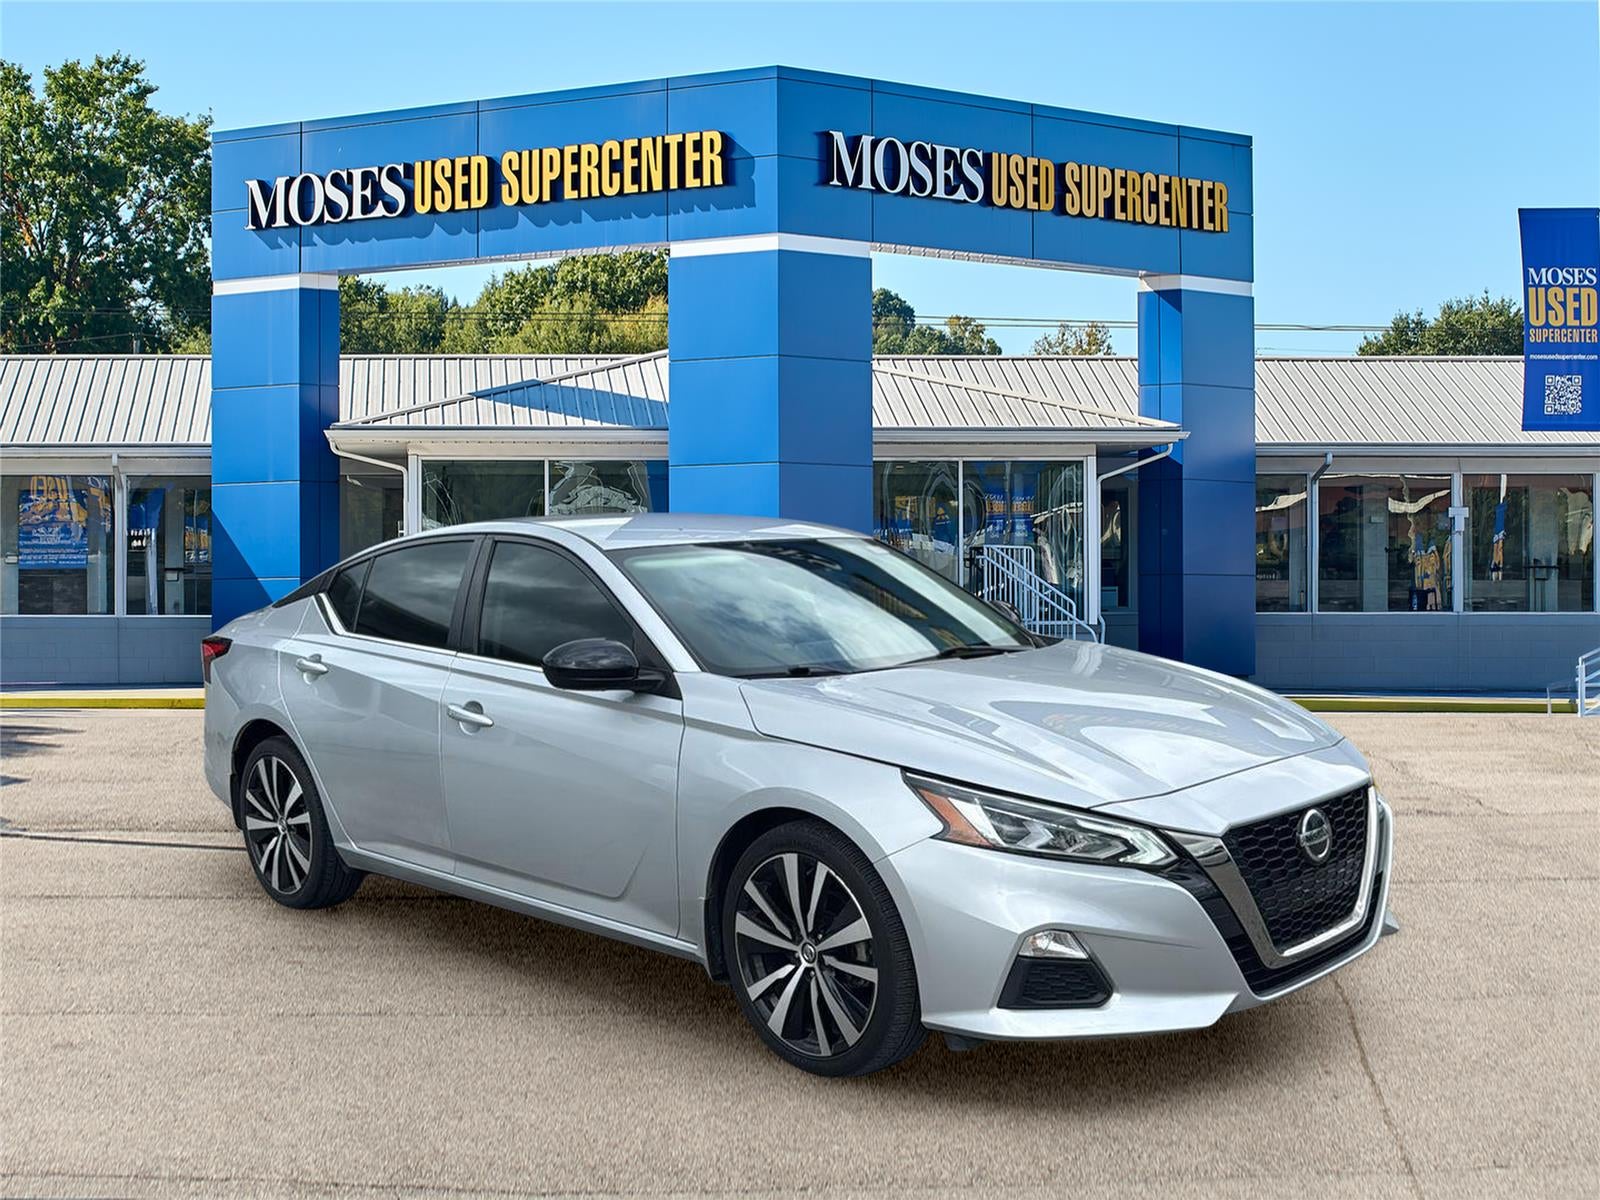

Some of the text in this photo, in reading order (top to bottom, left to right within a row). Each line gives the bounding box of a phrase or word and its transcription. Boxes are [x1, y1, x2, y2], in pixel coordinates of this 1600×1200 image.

[245, 130, 724, 230] MOSES USED SUPERCENTER
[828, 130, 1230, 233] MOSES USED SUPERCENTER
[1527, 267, 1598, 286] MOSES
[1528, 286, 1598, 327] USED
[1529, 328, 1599, 343] SUPERCENTER
